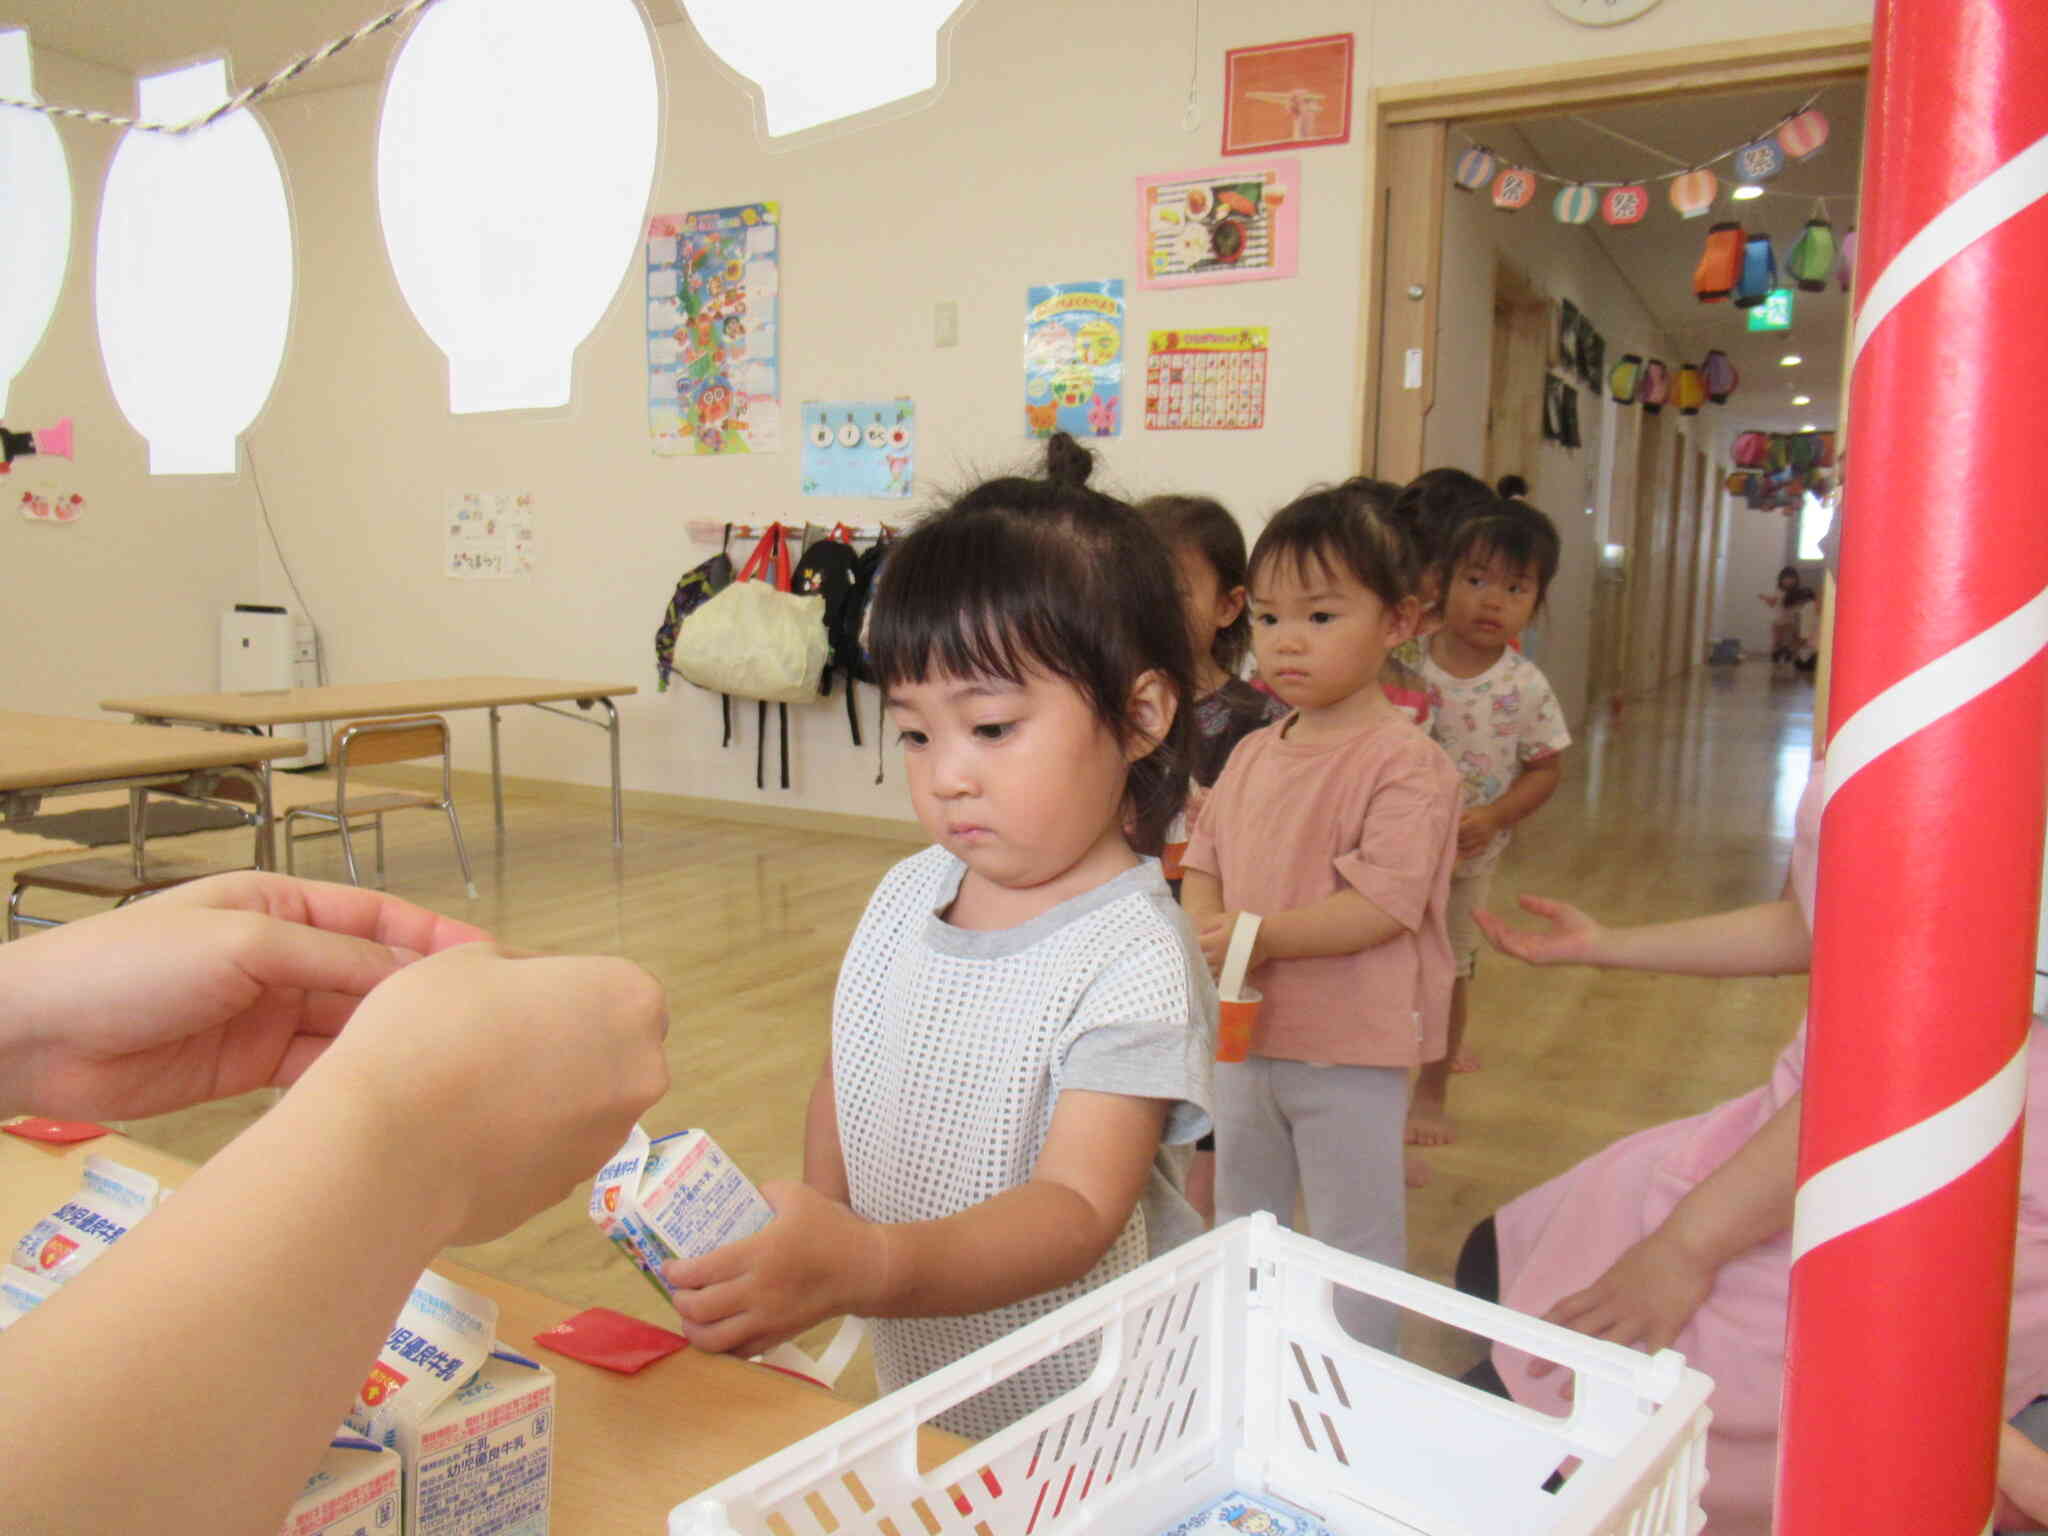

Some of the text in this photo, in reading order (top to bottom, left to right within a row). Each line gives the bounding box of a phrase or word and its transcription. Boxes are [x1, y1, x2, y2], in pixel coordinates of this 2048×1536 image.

[1745, 147, 1775, 176] 祭
[1503, 175, 1522, 201] 祭
[1614, 193, 1638, 217] 祭
[385, 1327, 465, 1381] 児優良牛乳
